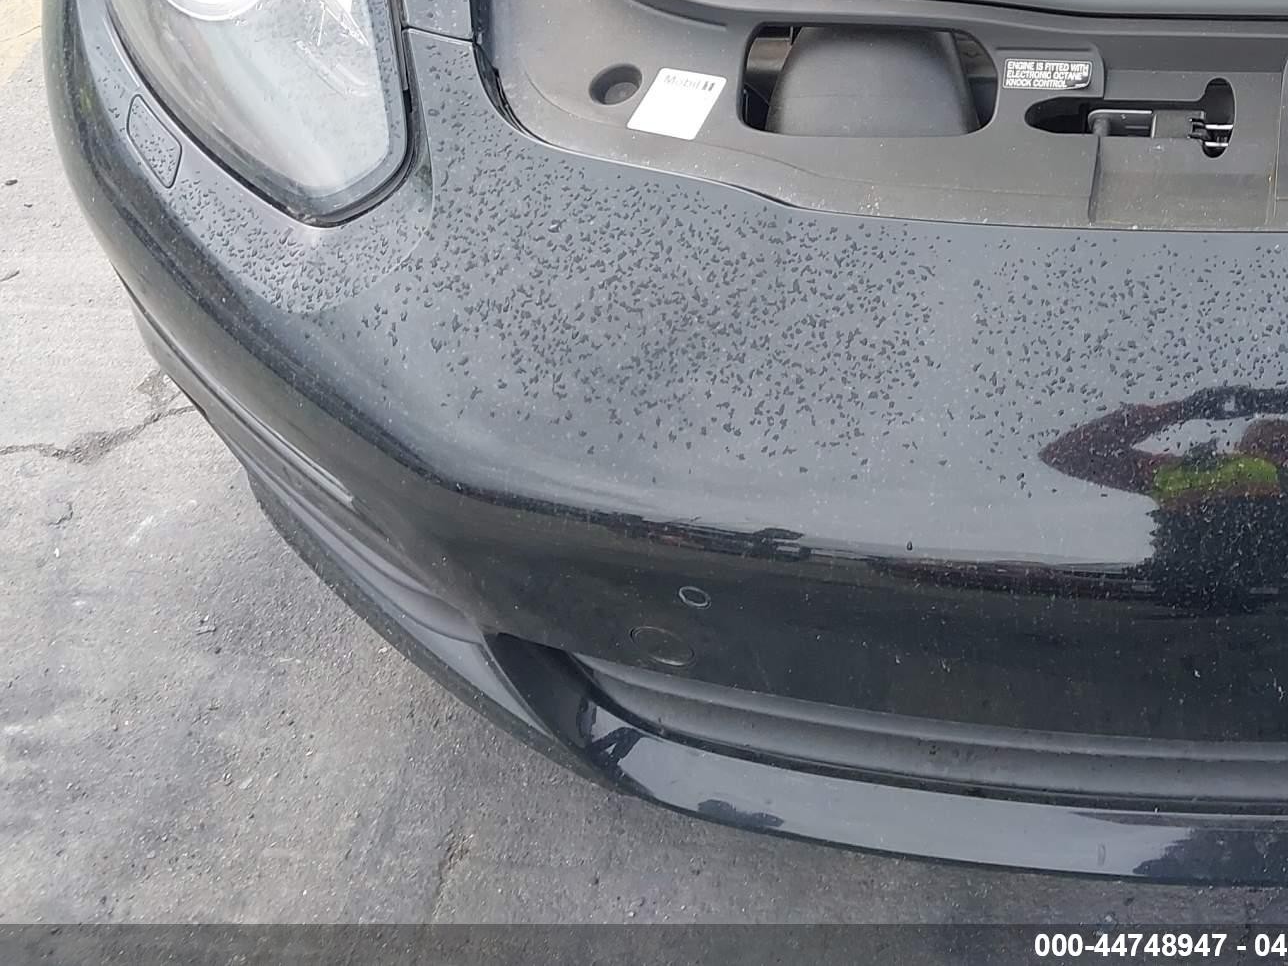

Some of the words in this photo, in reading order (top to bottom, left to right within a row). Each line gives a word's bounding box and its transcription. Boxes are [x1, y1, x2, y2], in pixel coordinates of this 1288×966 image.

[1007, 61, 1035, 70] ENGINE
[1036, 62, 1044, 71] IS
[1045, 63, 1069, 72] FITTED
[1070, 63, 1089, 72] WITH
[1007, 70, 1052, 79] ELECTRONIC
[1053, 71, 1083, 81] OCTANE
[1005, 78, 1032, 87] KNOCK
[1033, 79, 1068, 88] CONTROL
